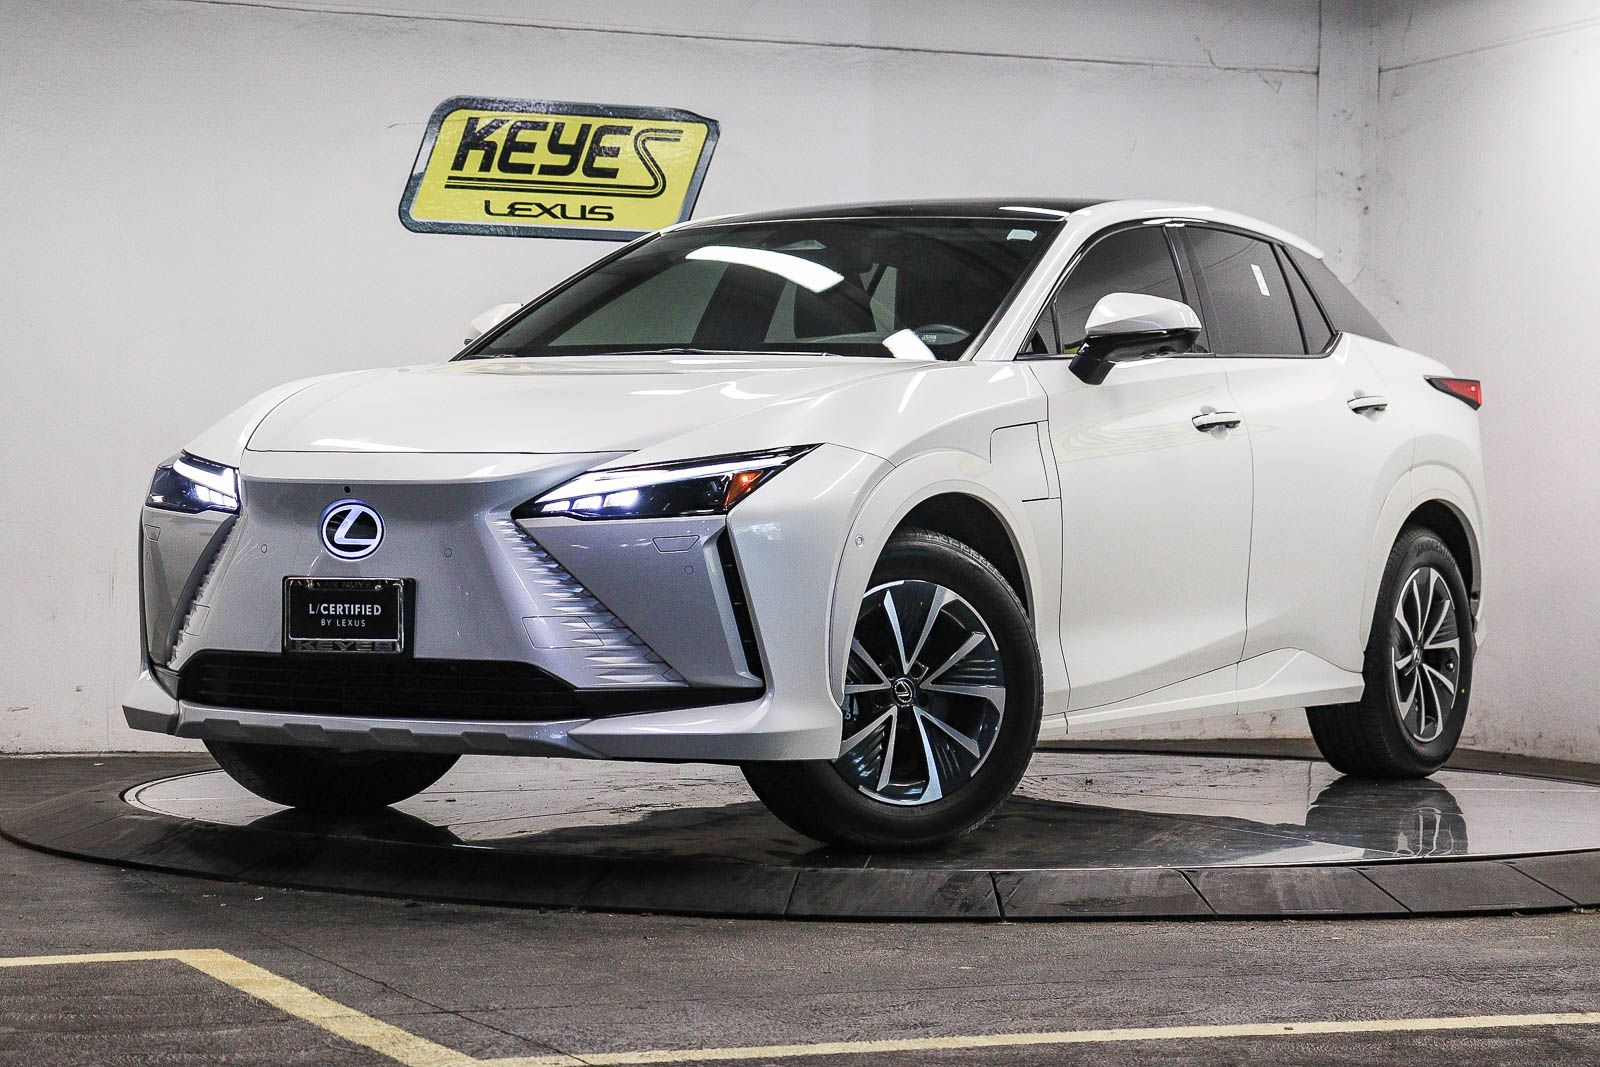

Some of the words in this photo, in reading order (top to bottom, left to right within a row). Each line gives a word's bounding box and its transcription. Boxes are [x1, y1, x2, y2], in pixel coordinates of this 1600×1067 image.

[445, 116, 683, 199] KEYES
[484, 200, 614, 221] LEXUS
[308, 603, 382, 616] L/CERTIFIED
[320, 618, 332, 627] BY
[336, 619, 366, 627] LEXUS
[296, 640, 394, 651] KEYES
